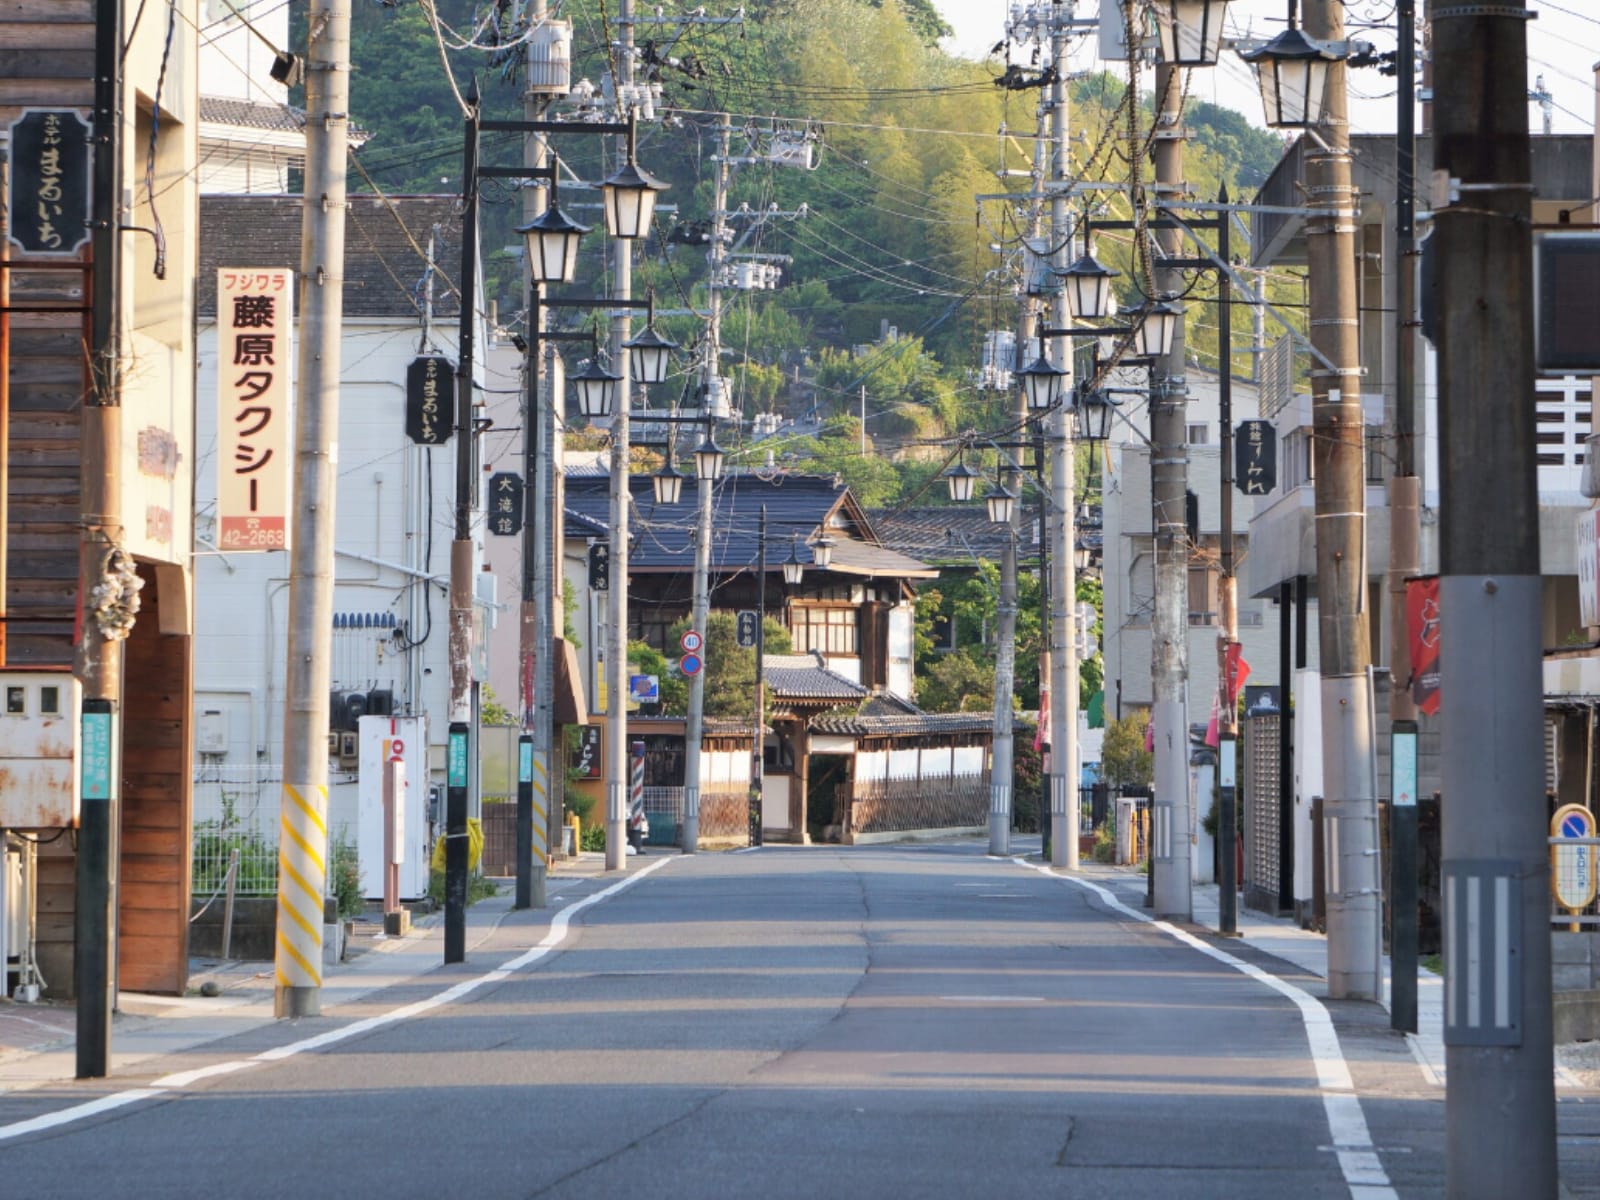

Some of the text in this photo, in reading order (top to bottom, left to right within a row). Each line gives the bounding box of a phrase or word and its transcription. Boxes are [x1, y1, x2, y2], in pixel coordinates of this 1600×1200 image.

[223, 274, 285, 291] フジワラ
[232, 295, 275, 512] 藤原タクシー
[223, 529, 285, 546] 42-2663
[686, 637, 698, 647] 40
